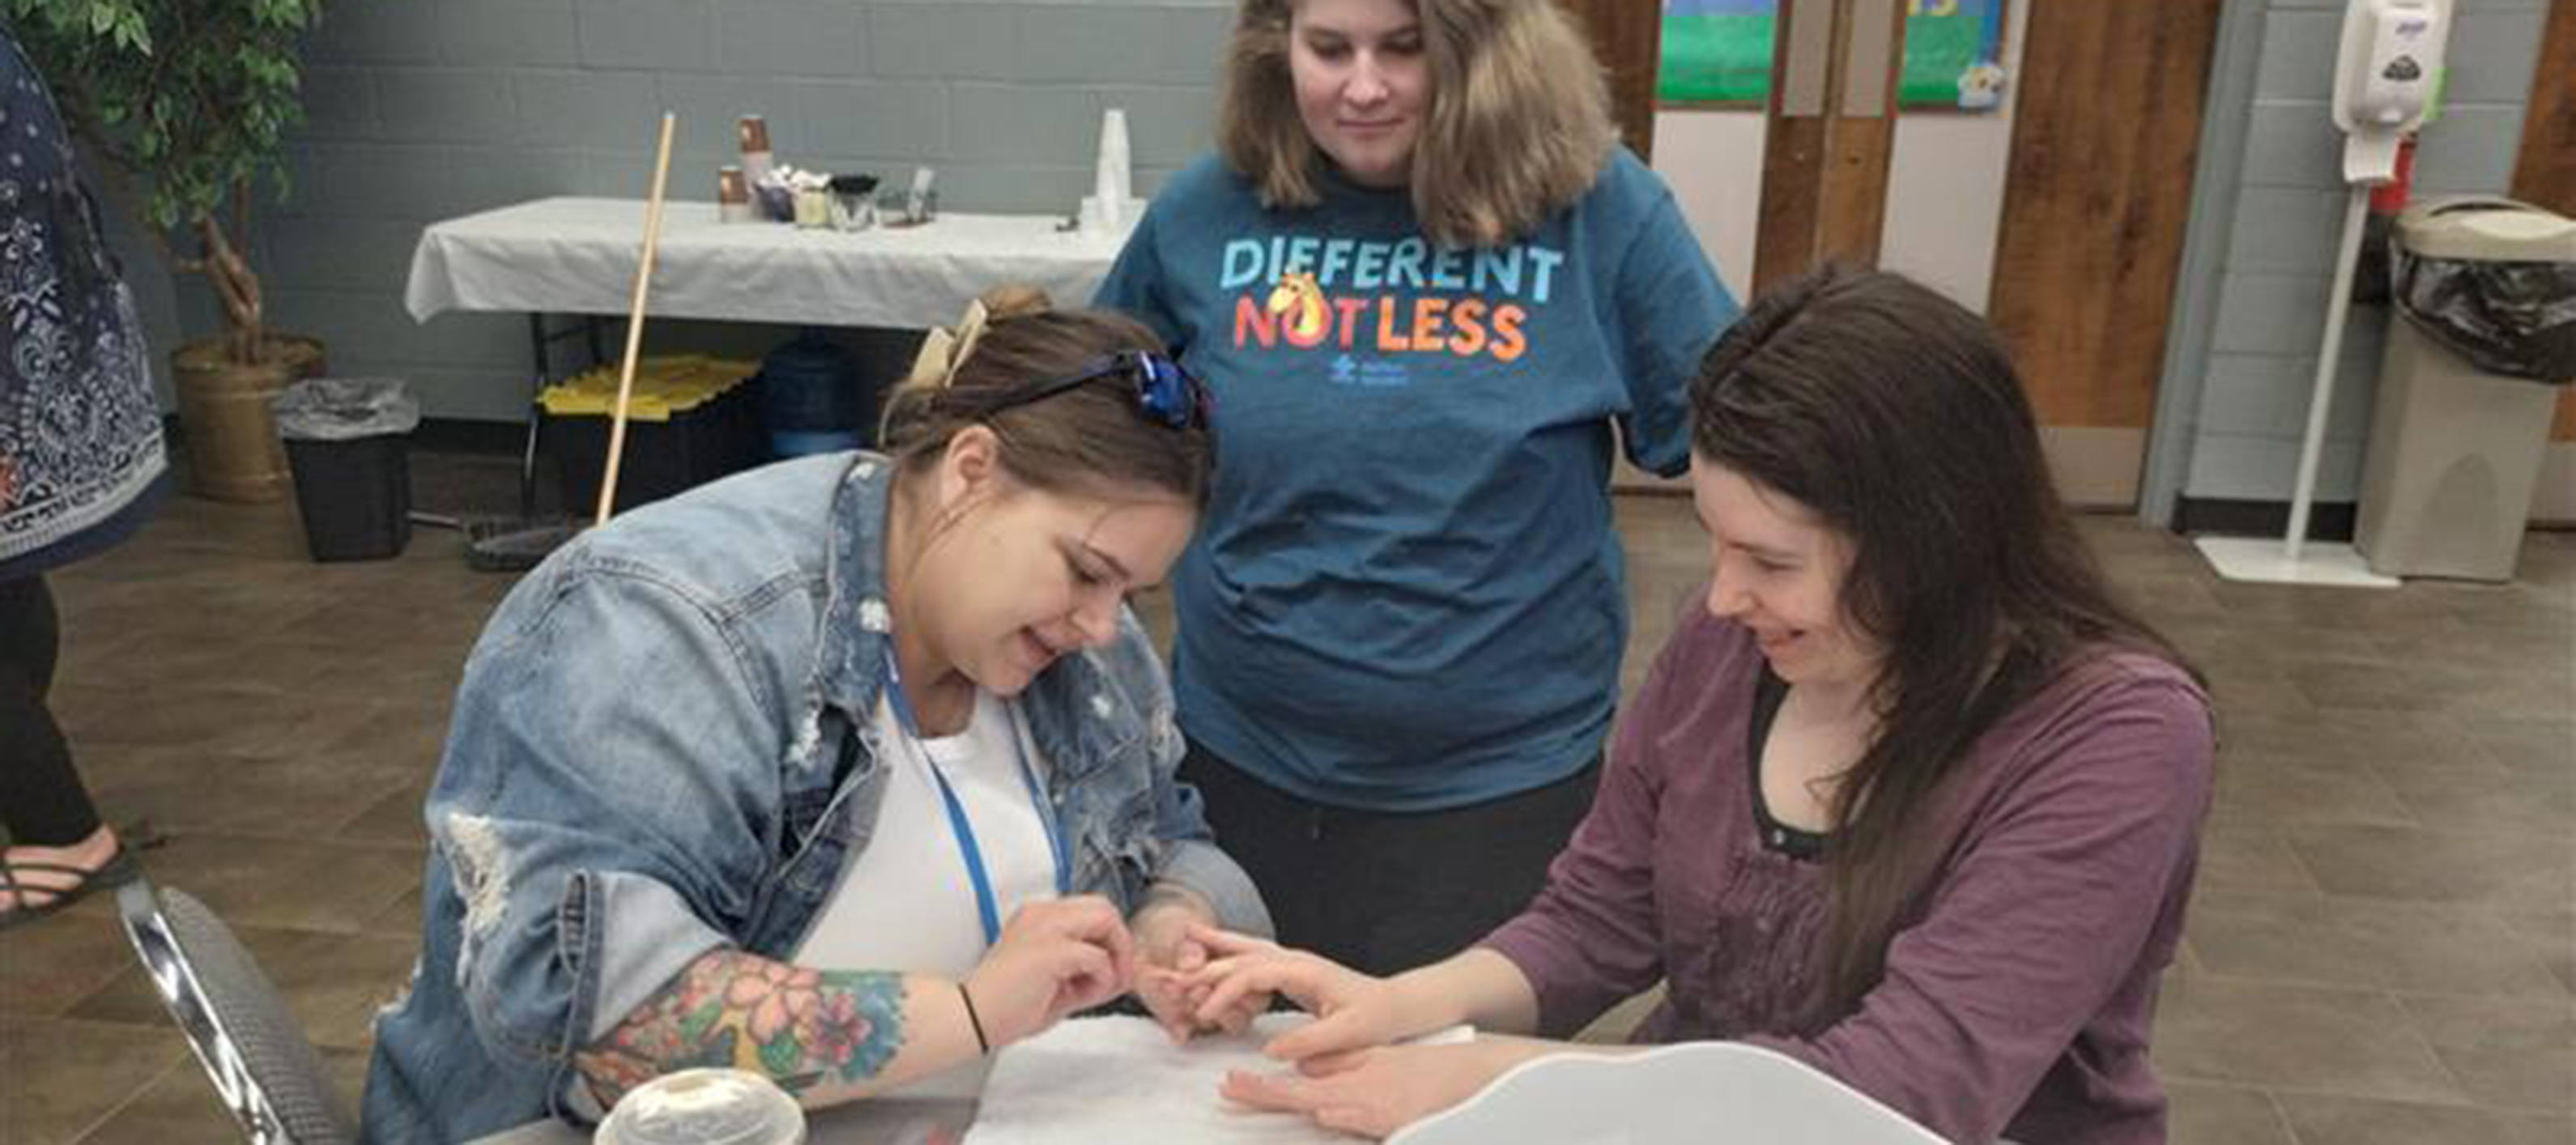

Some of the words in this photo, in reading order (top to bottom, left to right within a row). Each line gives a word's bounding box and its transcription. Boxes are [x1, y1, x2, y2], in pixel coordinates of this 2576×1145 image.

[1220, 236, 1565, 303] DIFFERENT
[1233, 293, 1369, 351] NOT
[1377, 296, 1527, 362] LESS
